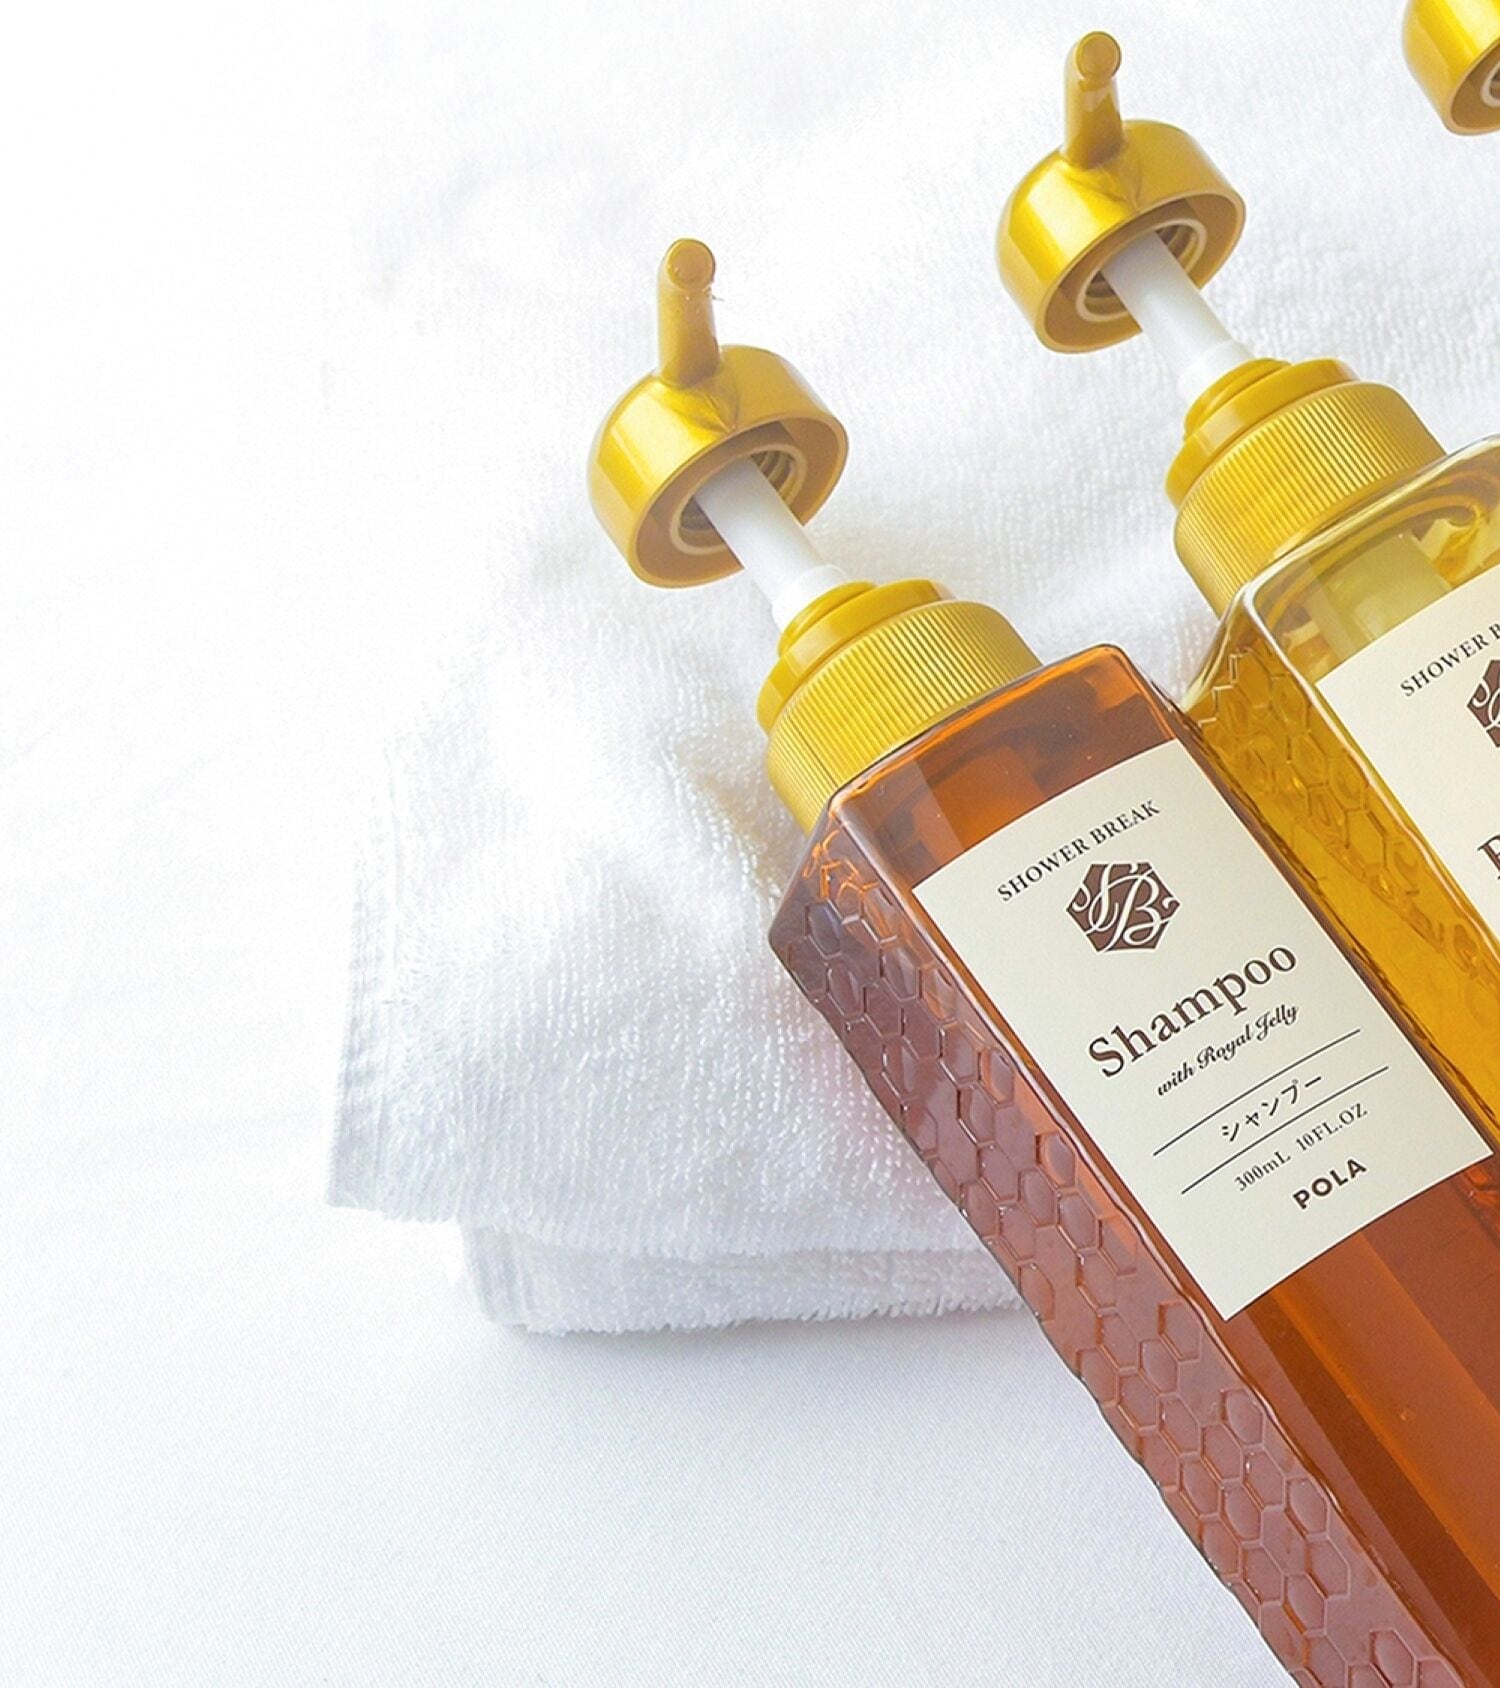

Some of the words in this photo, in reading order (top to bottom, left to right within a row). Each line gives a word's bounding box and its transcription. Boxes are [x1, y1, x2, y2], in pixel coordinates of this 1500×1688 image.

[1400, 631, 1490, 696] SHOWER
[996, 835, 1092, 902] SHOWER
[1089, 800, 1161, 845] BREAK
[1088, 946, 1297, 1078] Shampoo
[1156, 1060, 1196, 1096] with
[1196, 1025, 1254, 1070] Royal
[1255, 1002, 1299, 1042] Jelly
[1221, 1077, 1323, 1142] シャンプー
[1234, 1151, 1291, 1192] 300mL
[1292, 1158, 1368, 1210] POLA
